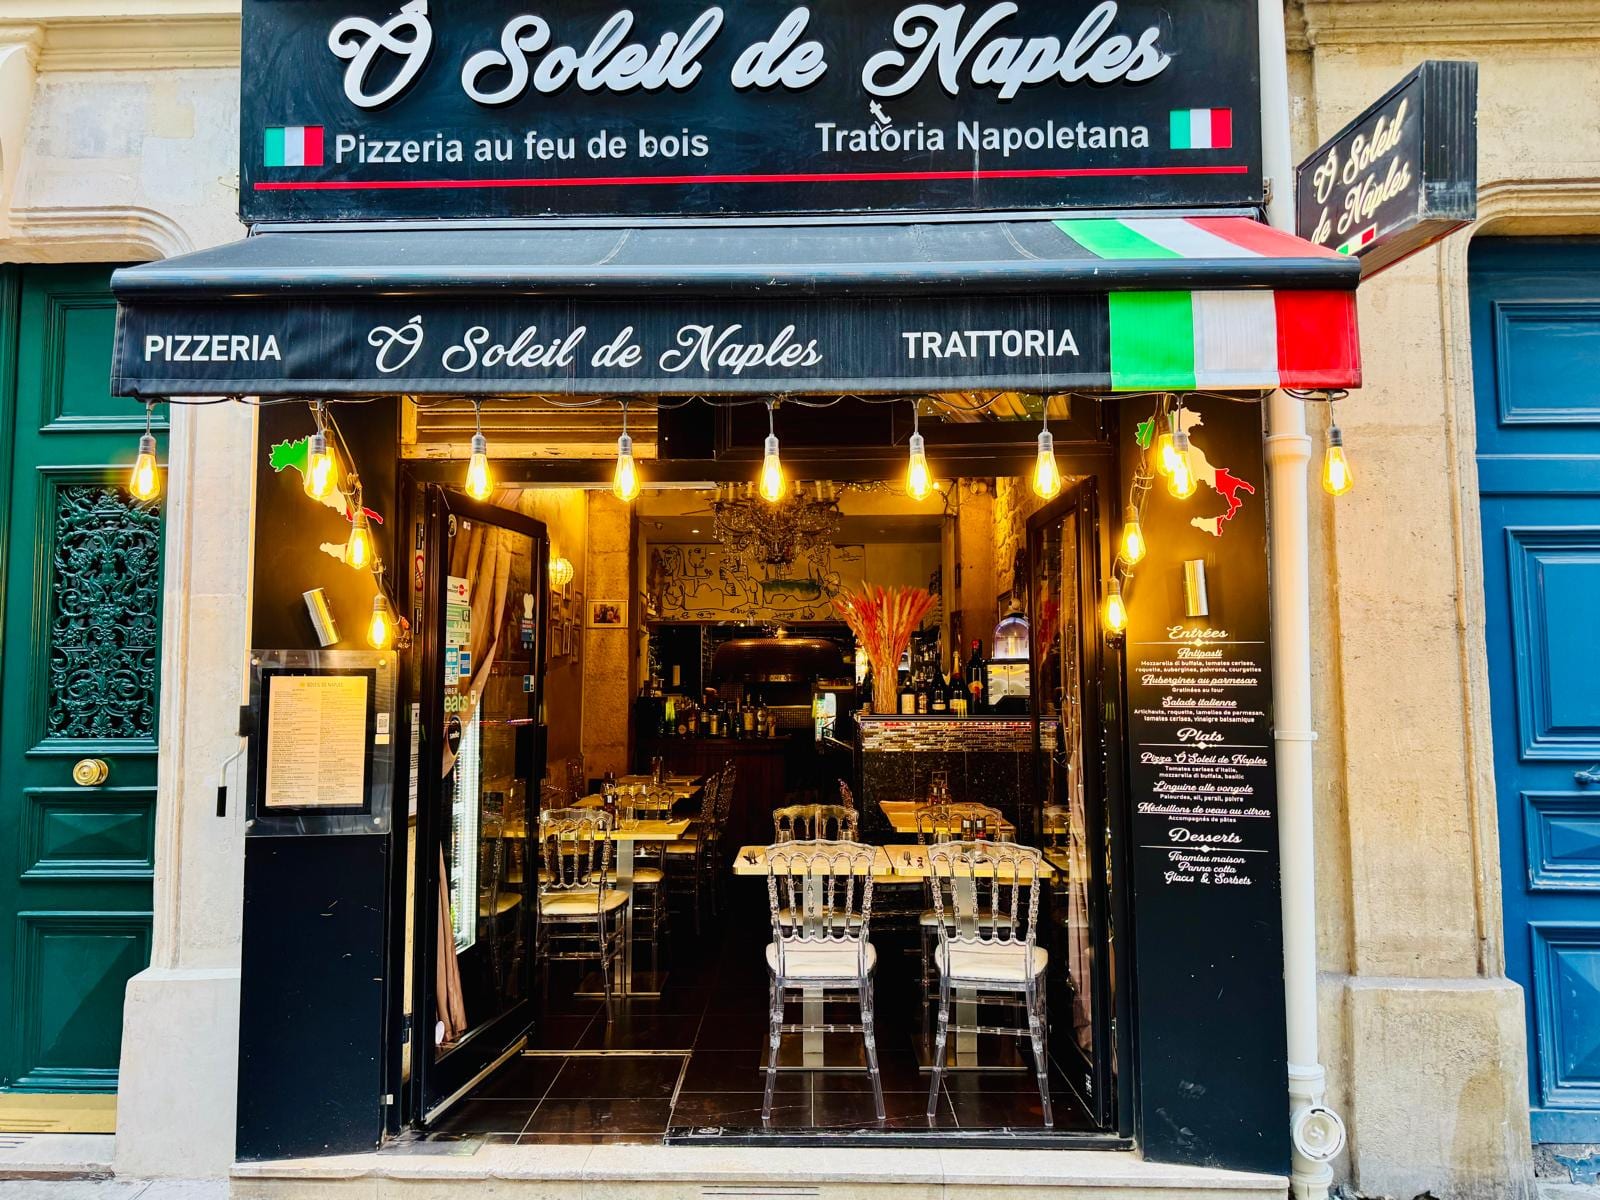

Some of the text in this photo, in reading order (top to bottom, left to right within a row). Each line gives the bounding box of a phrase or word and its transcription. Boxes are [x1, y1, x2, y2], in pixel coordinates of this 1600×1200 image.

[462, 6, 724, 104] Soleil
[731, 6, 828, 89] de
[862, 0, 1171, 99] Naples
[335, 128, 709, 164] Pizzeria au feu de bois
[957, 120, 1150, 157] Napoletana
[1342, 97, 1408, 185] Soleil
[1310, 155, 1411, 245] de Naples
[144, 334, 281, 362] PIZZERIA
[367, 314, 823, 375] Ô Soleil de Naples
[902, 329, 1079, 358] TRATTORIA
[1167, 625, 1229, 639] Entrées
[1141, 674, 1196, 686] Aubergines
[1210, 677, 1258, 686] parmesan
[444, 691, 469, 713] eats
[1162, 695, 1197, 706] Salade
[1176, 727, 1225, 742] Plats
[1140, 752, 1173, 764] Pizza
[1188, 753, 1217, 764] Soleil
[1217, 755, 1230, 764] de
[1231, 754, 1268, 766] Naples
[1153, 780, 1254, 795] Linguine alle vongole
[1137, 802, 1191, 813] Médaillons
[1192, 805, 1205, 814] de
[1243, 807, 1271, 816] citron
[1168, 827, 1243, 844] Desserts
[1168, 850, 1246, 864] Tiramisu maison
[1177, 861, 1237, 874] Panna cotta
[1200, 873, 1210, 884] &
[1214, 873, 1252, 885] Sorbets
